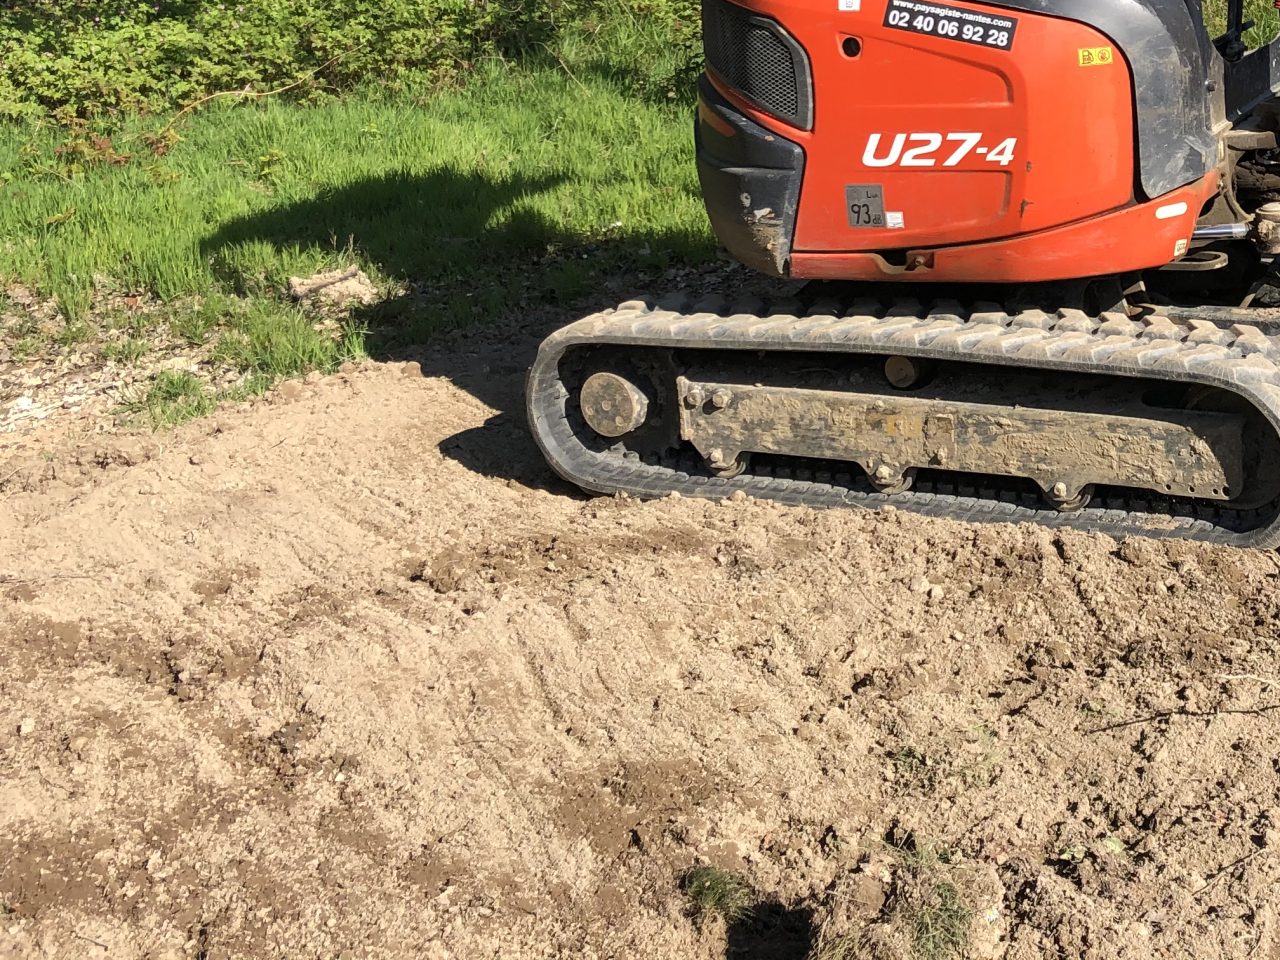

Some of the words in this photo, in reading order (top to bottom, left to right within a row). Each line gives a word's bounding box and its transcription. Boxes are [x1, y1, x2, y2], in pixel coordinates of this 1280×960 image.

[888, 10, 909, 28] 02
[912, 16, 935, 32] 40
[937, 19, 959, 37] 06
[961, 24, 984, 42] 92
[986, 30, 1009, 47] 28
[892, 0, 1012, 29] www.paysagiste-nantes.com
[862, 132, 1017, 167] U27-4
[851, 203, 871, 225] 93
